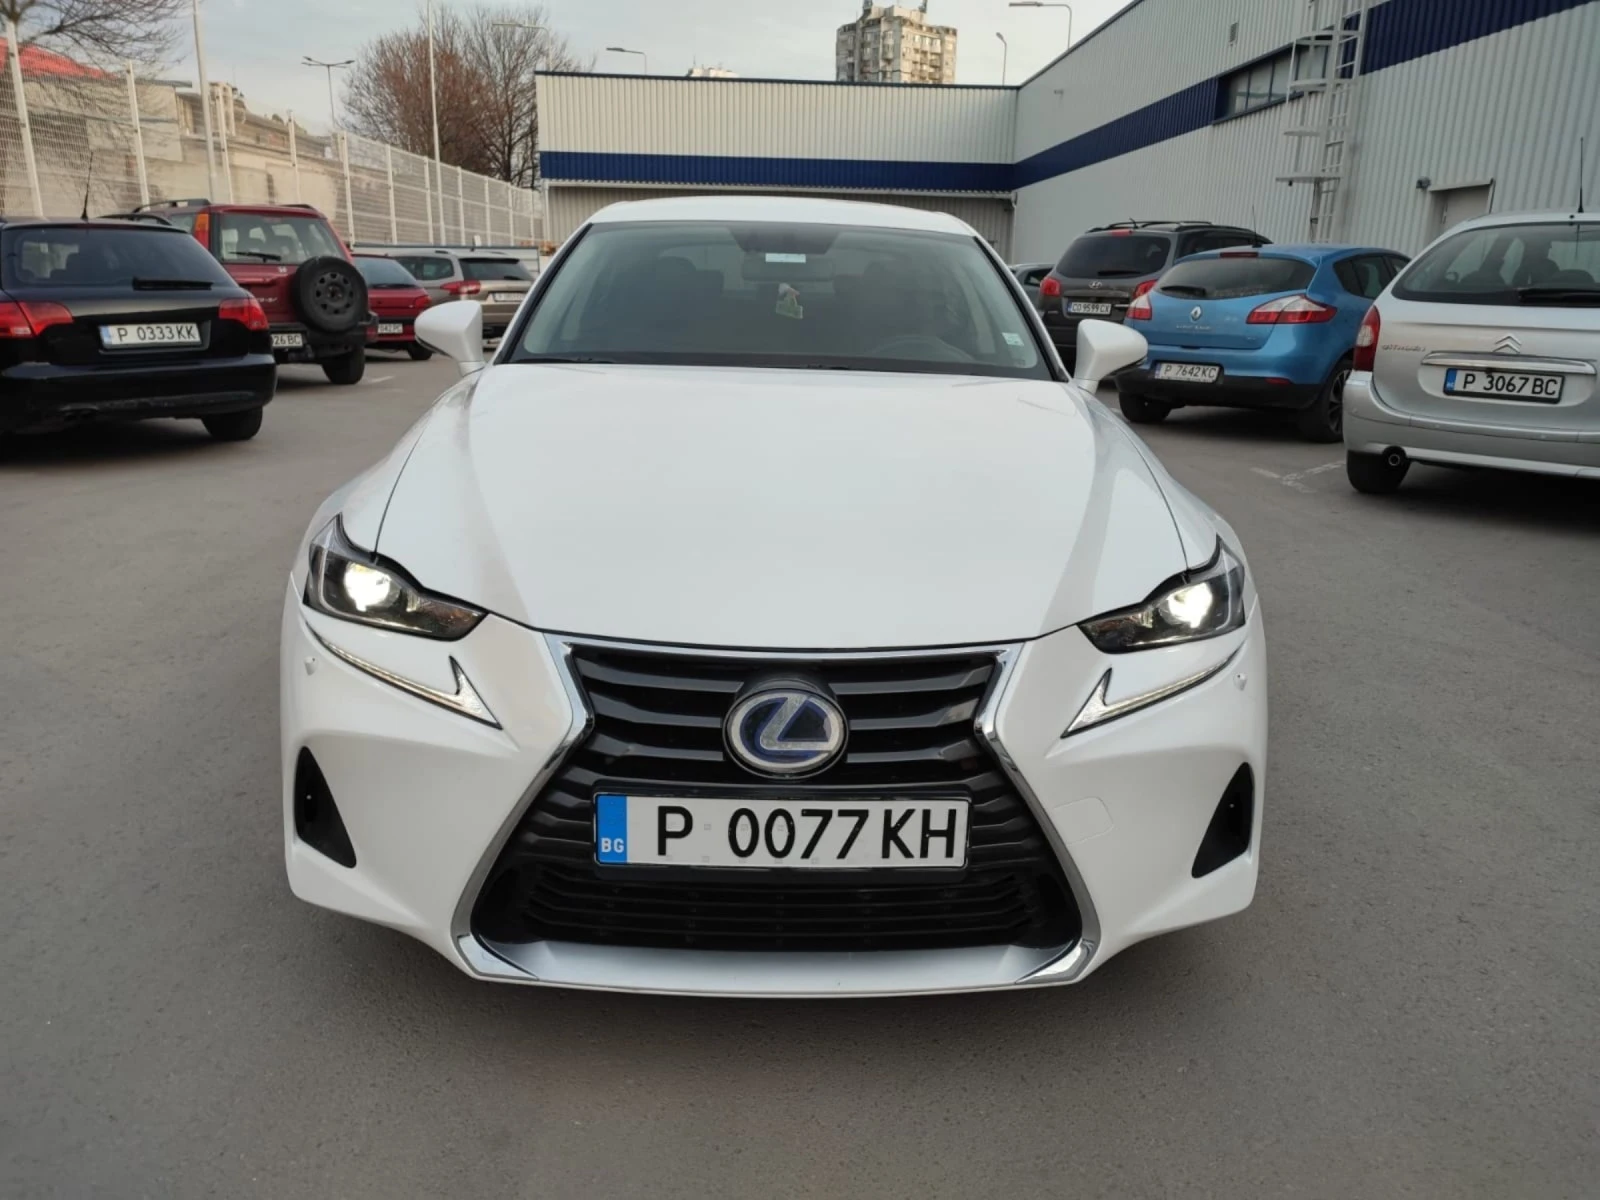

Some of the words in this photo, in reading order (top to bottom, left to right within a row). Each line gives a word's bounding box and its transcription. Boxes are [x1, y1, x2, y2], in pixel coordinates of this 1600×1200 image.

[117, 326, 128, 341] P
[1164, 364, 1172, 375] P
[1463, 373, 1476, 389] P
[657, 805, 694, 856] P
[601, 837, 625, 853] BG
